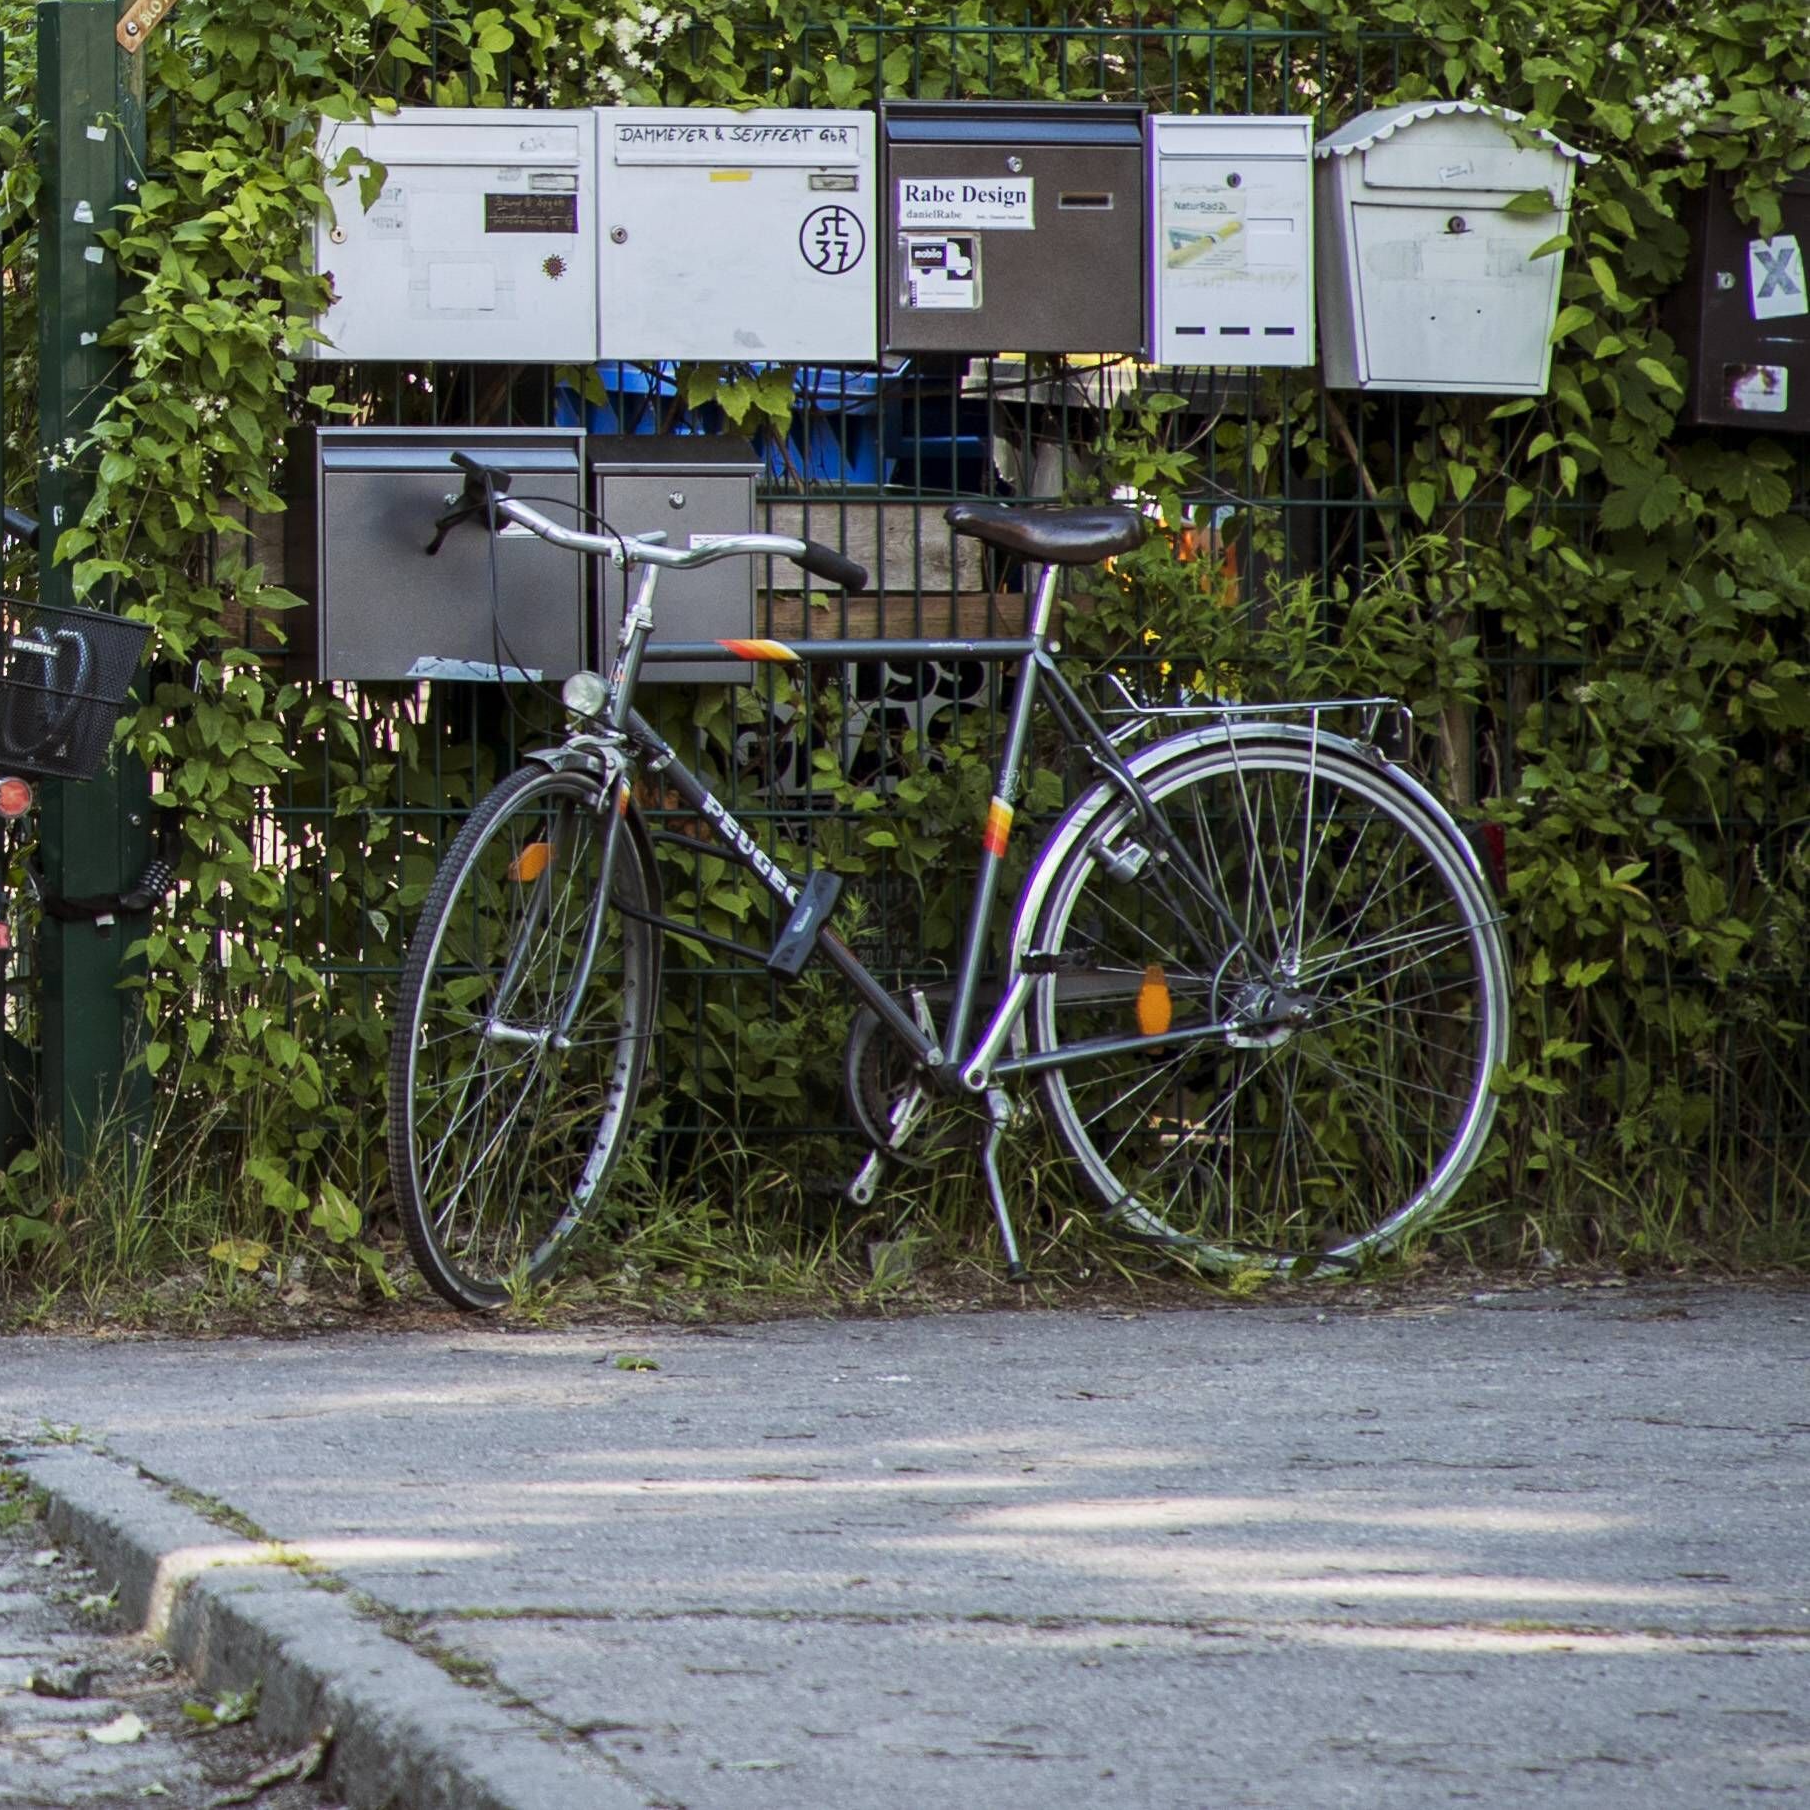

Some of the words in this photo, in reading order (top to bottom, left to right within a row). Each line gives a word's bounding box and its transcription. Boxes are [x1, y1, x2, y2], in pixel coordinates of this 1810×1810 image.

[138, 0, 163, 26] BLO
[619, 127, 709, 144] DAMMEYER
[715, 127, 724, 141] &
[729, 126, 813, 143] SEYFFERT
[819, 128, 848, 144] GbR
[905, 184, 955, 203] Rabe
[962, 185, 1027, 207] Design
[906, 209, 962, 220] danielRabe
[815, 240, 848, 272] 37
